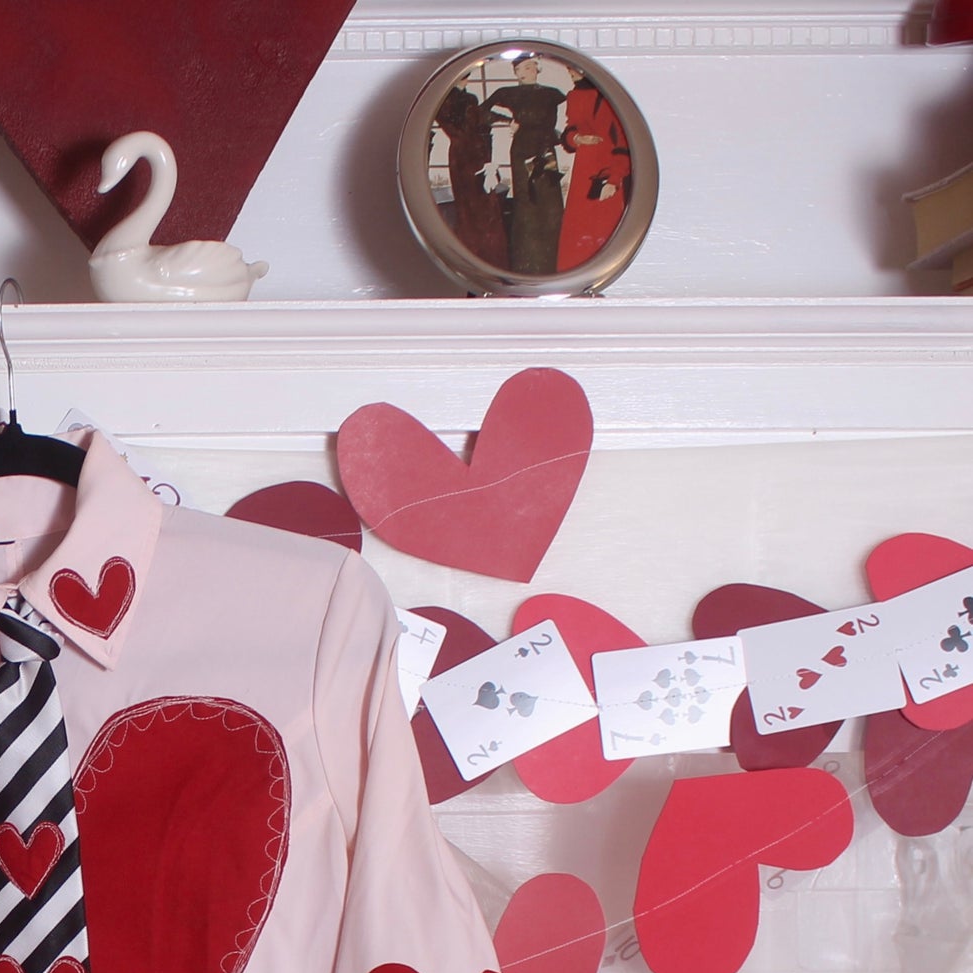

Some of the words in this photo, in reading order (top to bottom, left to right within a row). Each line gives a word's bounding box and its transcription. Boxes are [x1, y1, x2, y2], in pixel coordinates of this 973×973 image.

[856, 614, 880, 634] 2
[410, 627, 438, 645] 4
[529, 633, 553, 655] 2
[701, 646, 736, 666] 7
[919, 668, 944, 690] 2
[762, 706, 787, 726] 2
[610, 729, 645, 751] 7
[466, 744, 490, 766] 2
